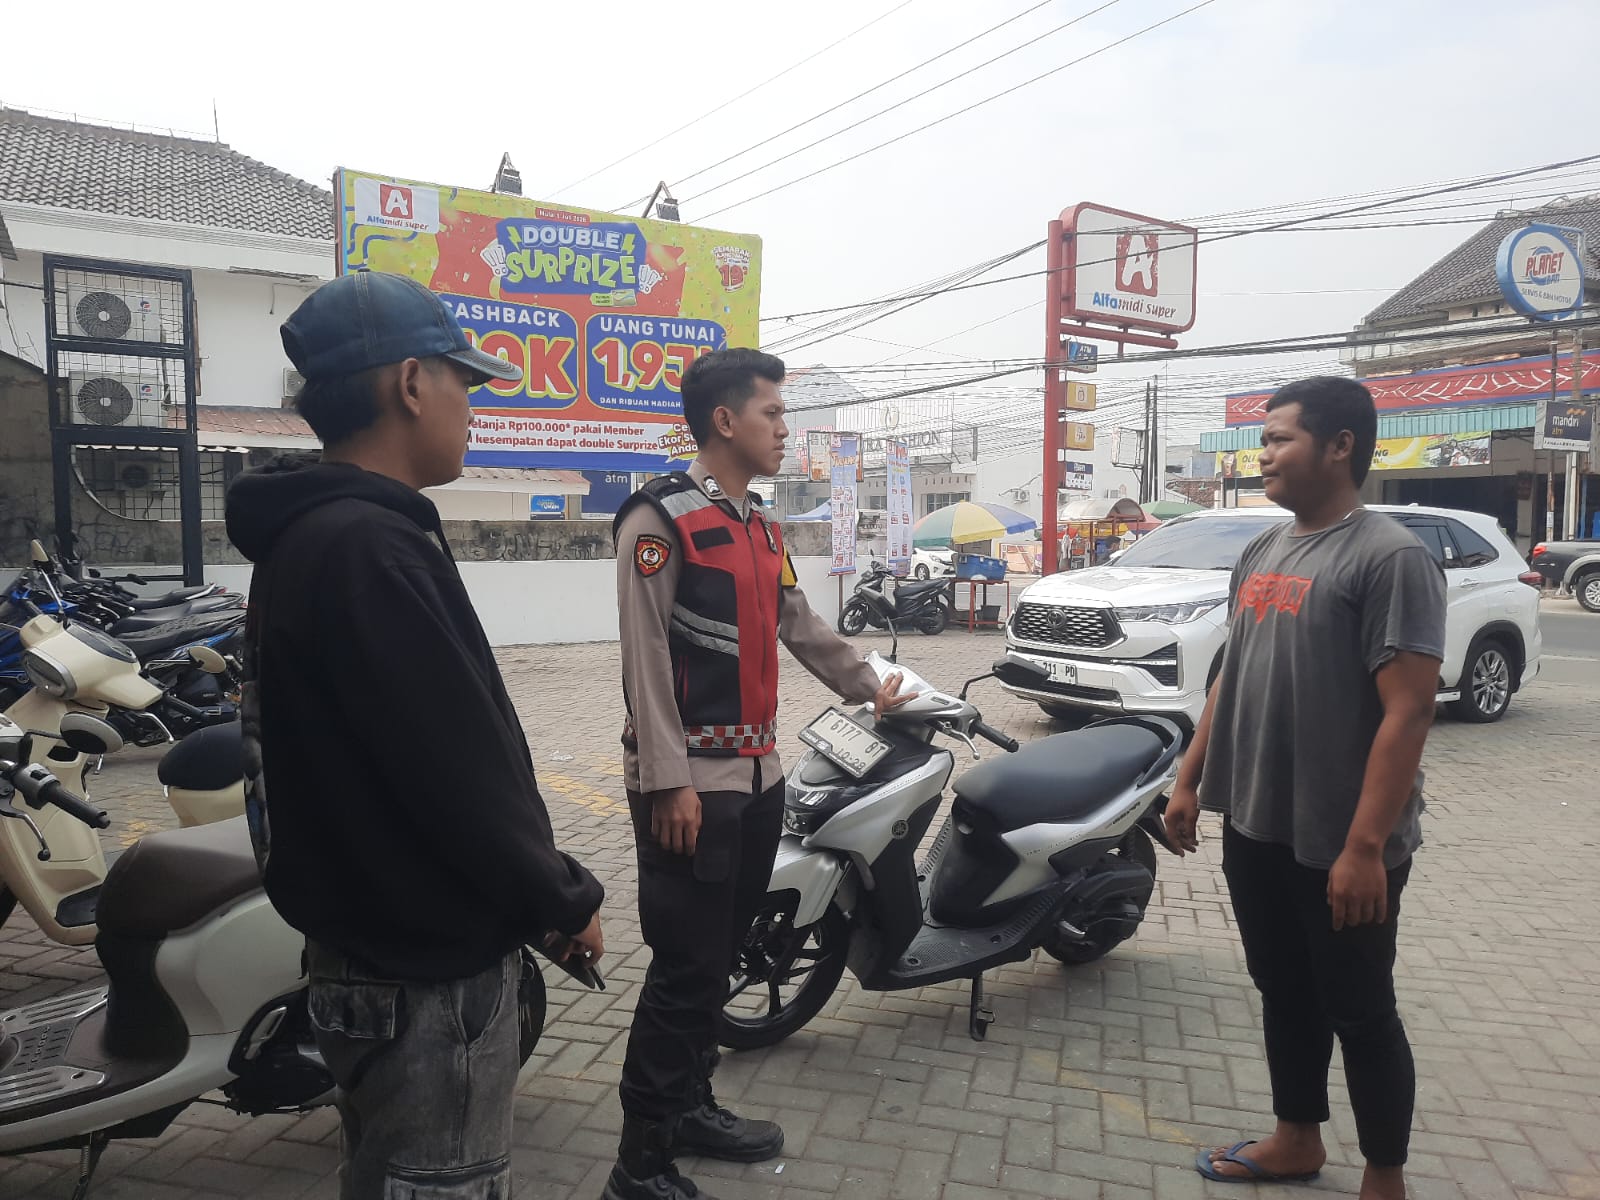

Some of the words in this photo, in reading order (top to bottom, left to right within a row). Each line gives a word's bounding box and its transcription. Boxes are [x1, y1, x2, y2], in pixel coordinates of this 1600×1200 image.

[366, 214, 403, 228] Alfamidi
[403, 218, 429, 231] super
[523, 226, 621, 250] DOUBLE
[505, 246, 637, 288] SURPRIZE
[1525, 251, 1565, 277] PLANET
[1092, 291, 1144, 313] Alfamidi
[1145, 302, 1177, 319] super
[600, 316, 654, 336] UANG
[659, 322, 715, 342] TUNAI
[463, 329, 576, 395] 0K
[599, 396, 617, 405] DAN
[618, 397, 649, 407] RIBUAN
[651, 400, 681, 408] HADIAH
[573, 423, 602, 436] pakai
[603, 424, 645, 436] Member
[475, 433, 544, 448] kesempatan
[545, 436, 577, 450] dapat
[579, 437, 615, 449] double
[616, 439, 658, 452] Surprize
[658, 433, 682, 448] Ekor
[671, 443, 698, 455] Anda
[605, 473, 628, 484] atm
[830, 718, 863, 743] 6177
